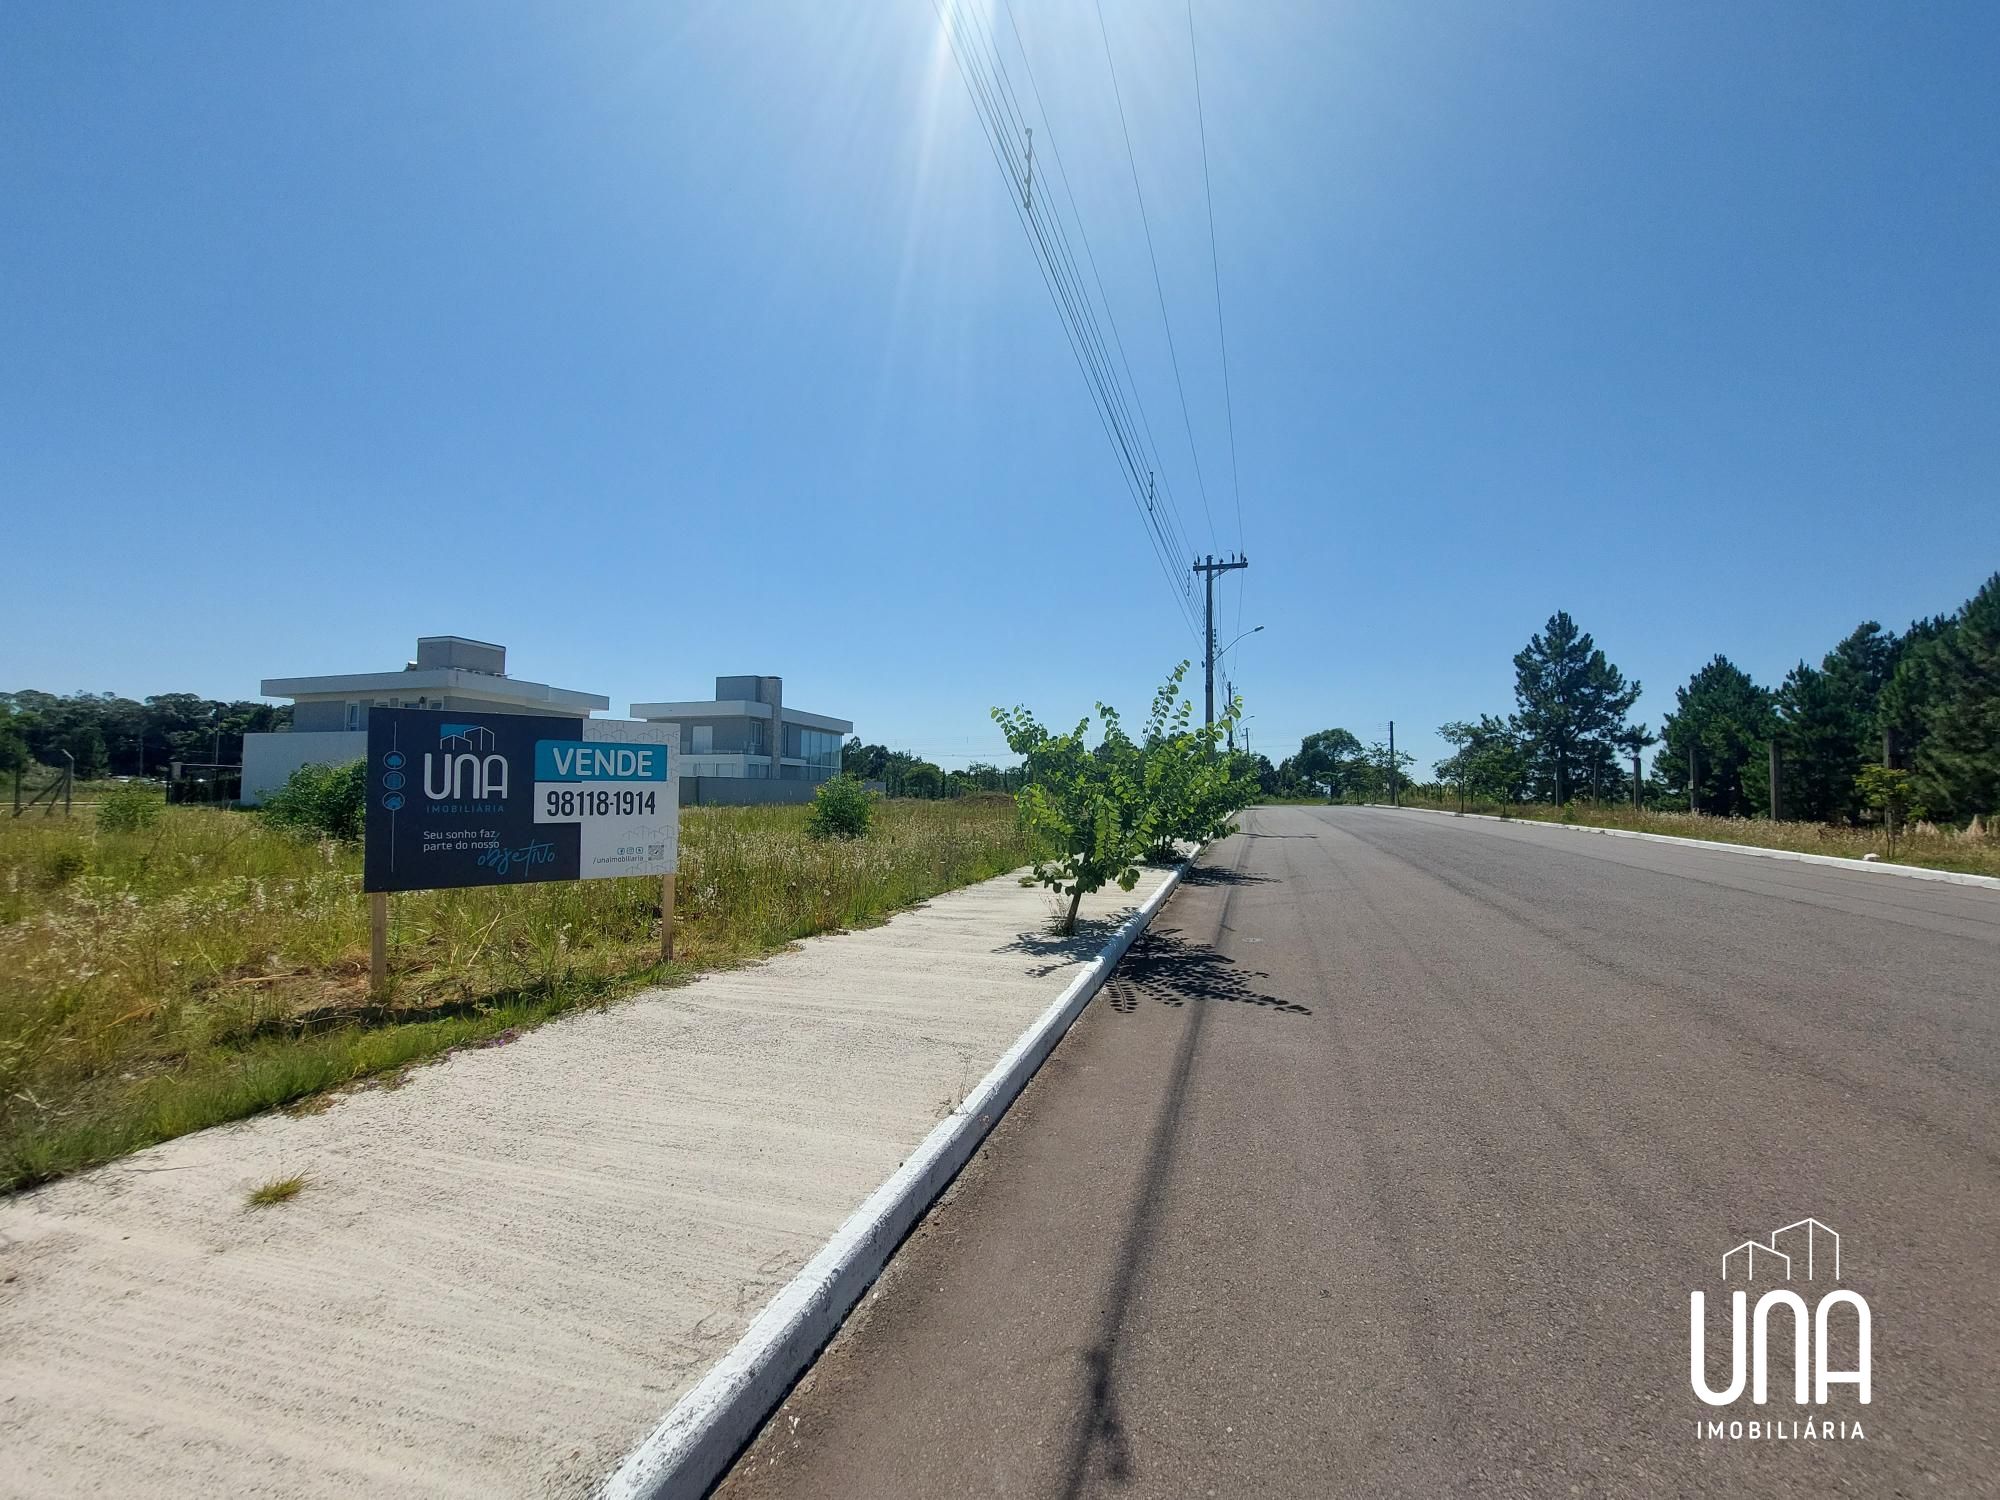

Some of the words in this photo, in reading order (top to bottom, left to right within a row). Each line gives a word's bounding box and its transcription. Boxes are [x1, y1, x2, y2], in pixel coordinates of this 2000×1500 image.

[553, 747, 653, 777] VENDE
[424, 752, 509, 801] UNA
[547, 790, 656, 817] 98118-1914
[423, 830, 443, 840] Seu
[446, 829, 477, 839] sonho
[480, 829, 496, 838] faz
[423, 841, 453, 853] parte
[455, 840, 468, 850] do
[471, 840, 500, 849] nosso
[477, 832, 556, 877] objetivo
